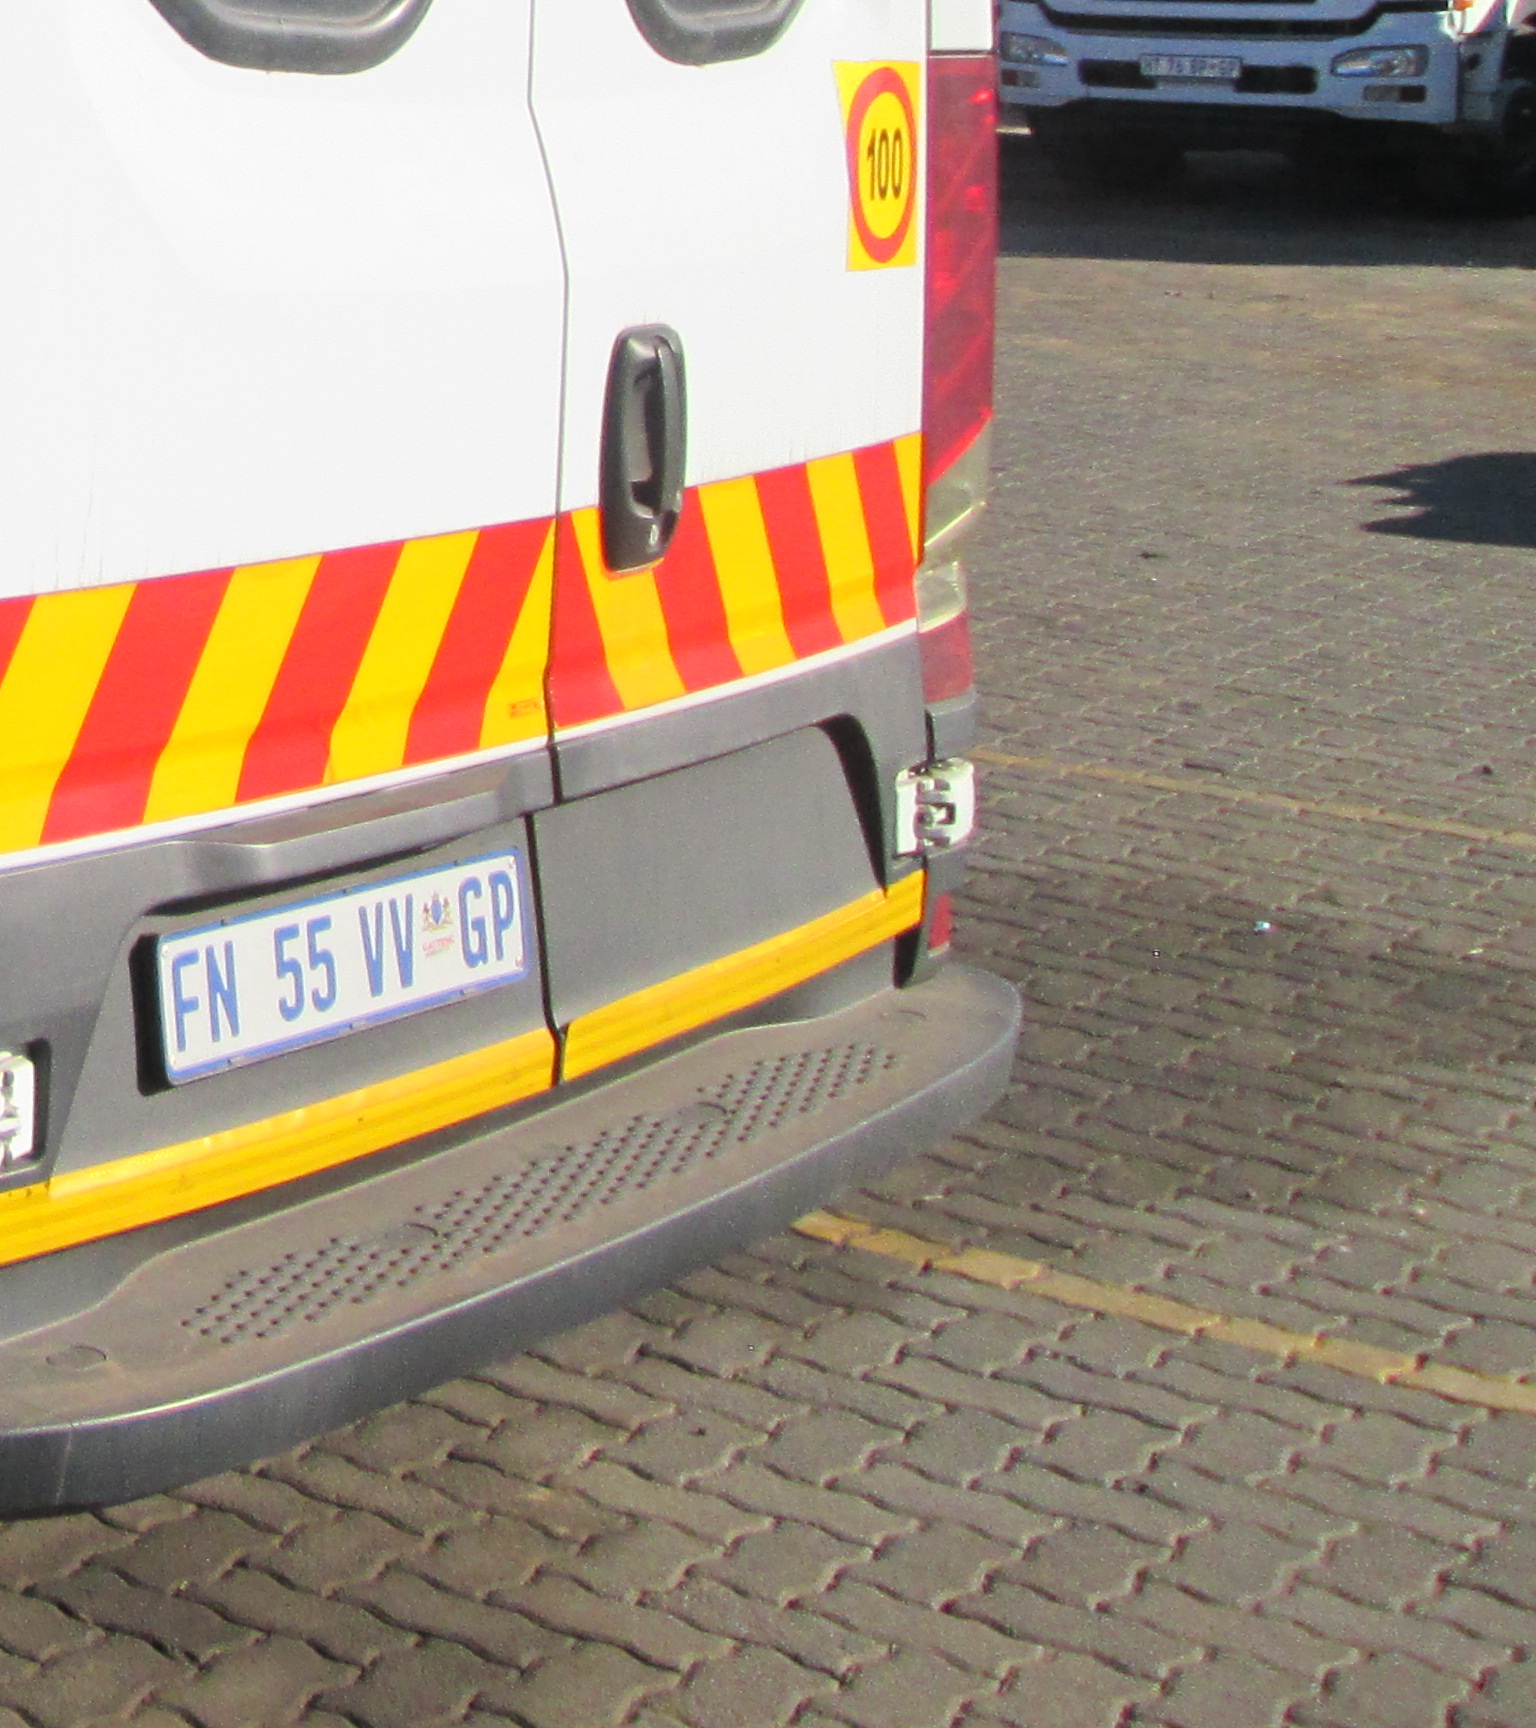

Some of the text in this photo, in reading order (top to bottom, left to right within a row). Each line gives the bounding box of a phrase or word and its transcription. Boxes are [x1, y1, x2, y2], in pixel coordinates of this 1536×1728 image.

[868, 128, 902, 200] 100
[172, 870, 515, 1051] FN 55 VV GP
